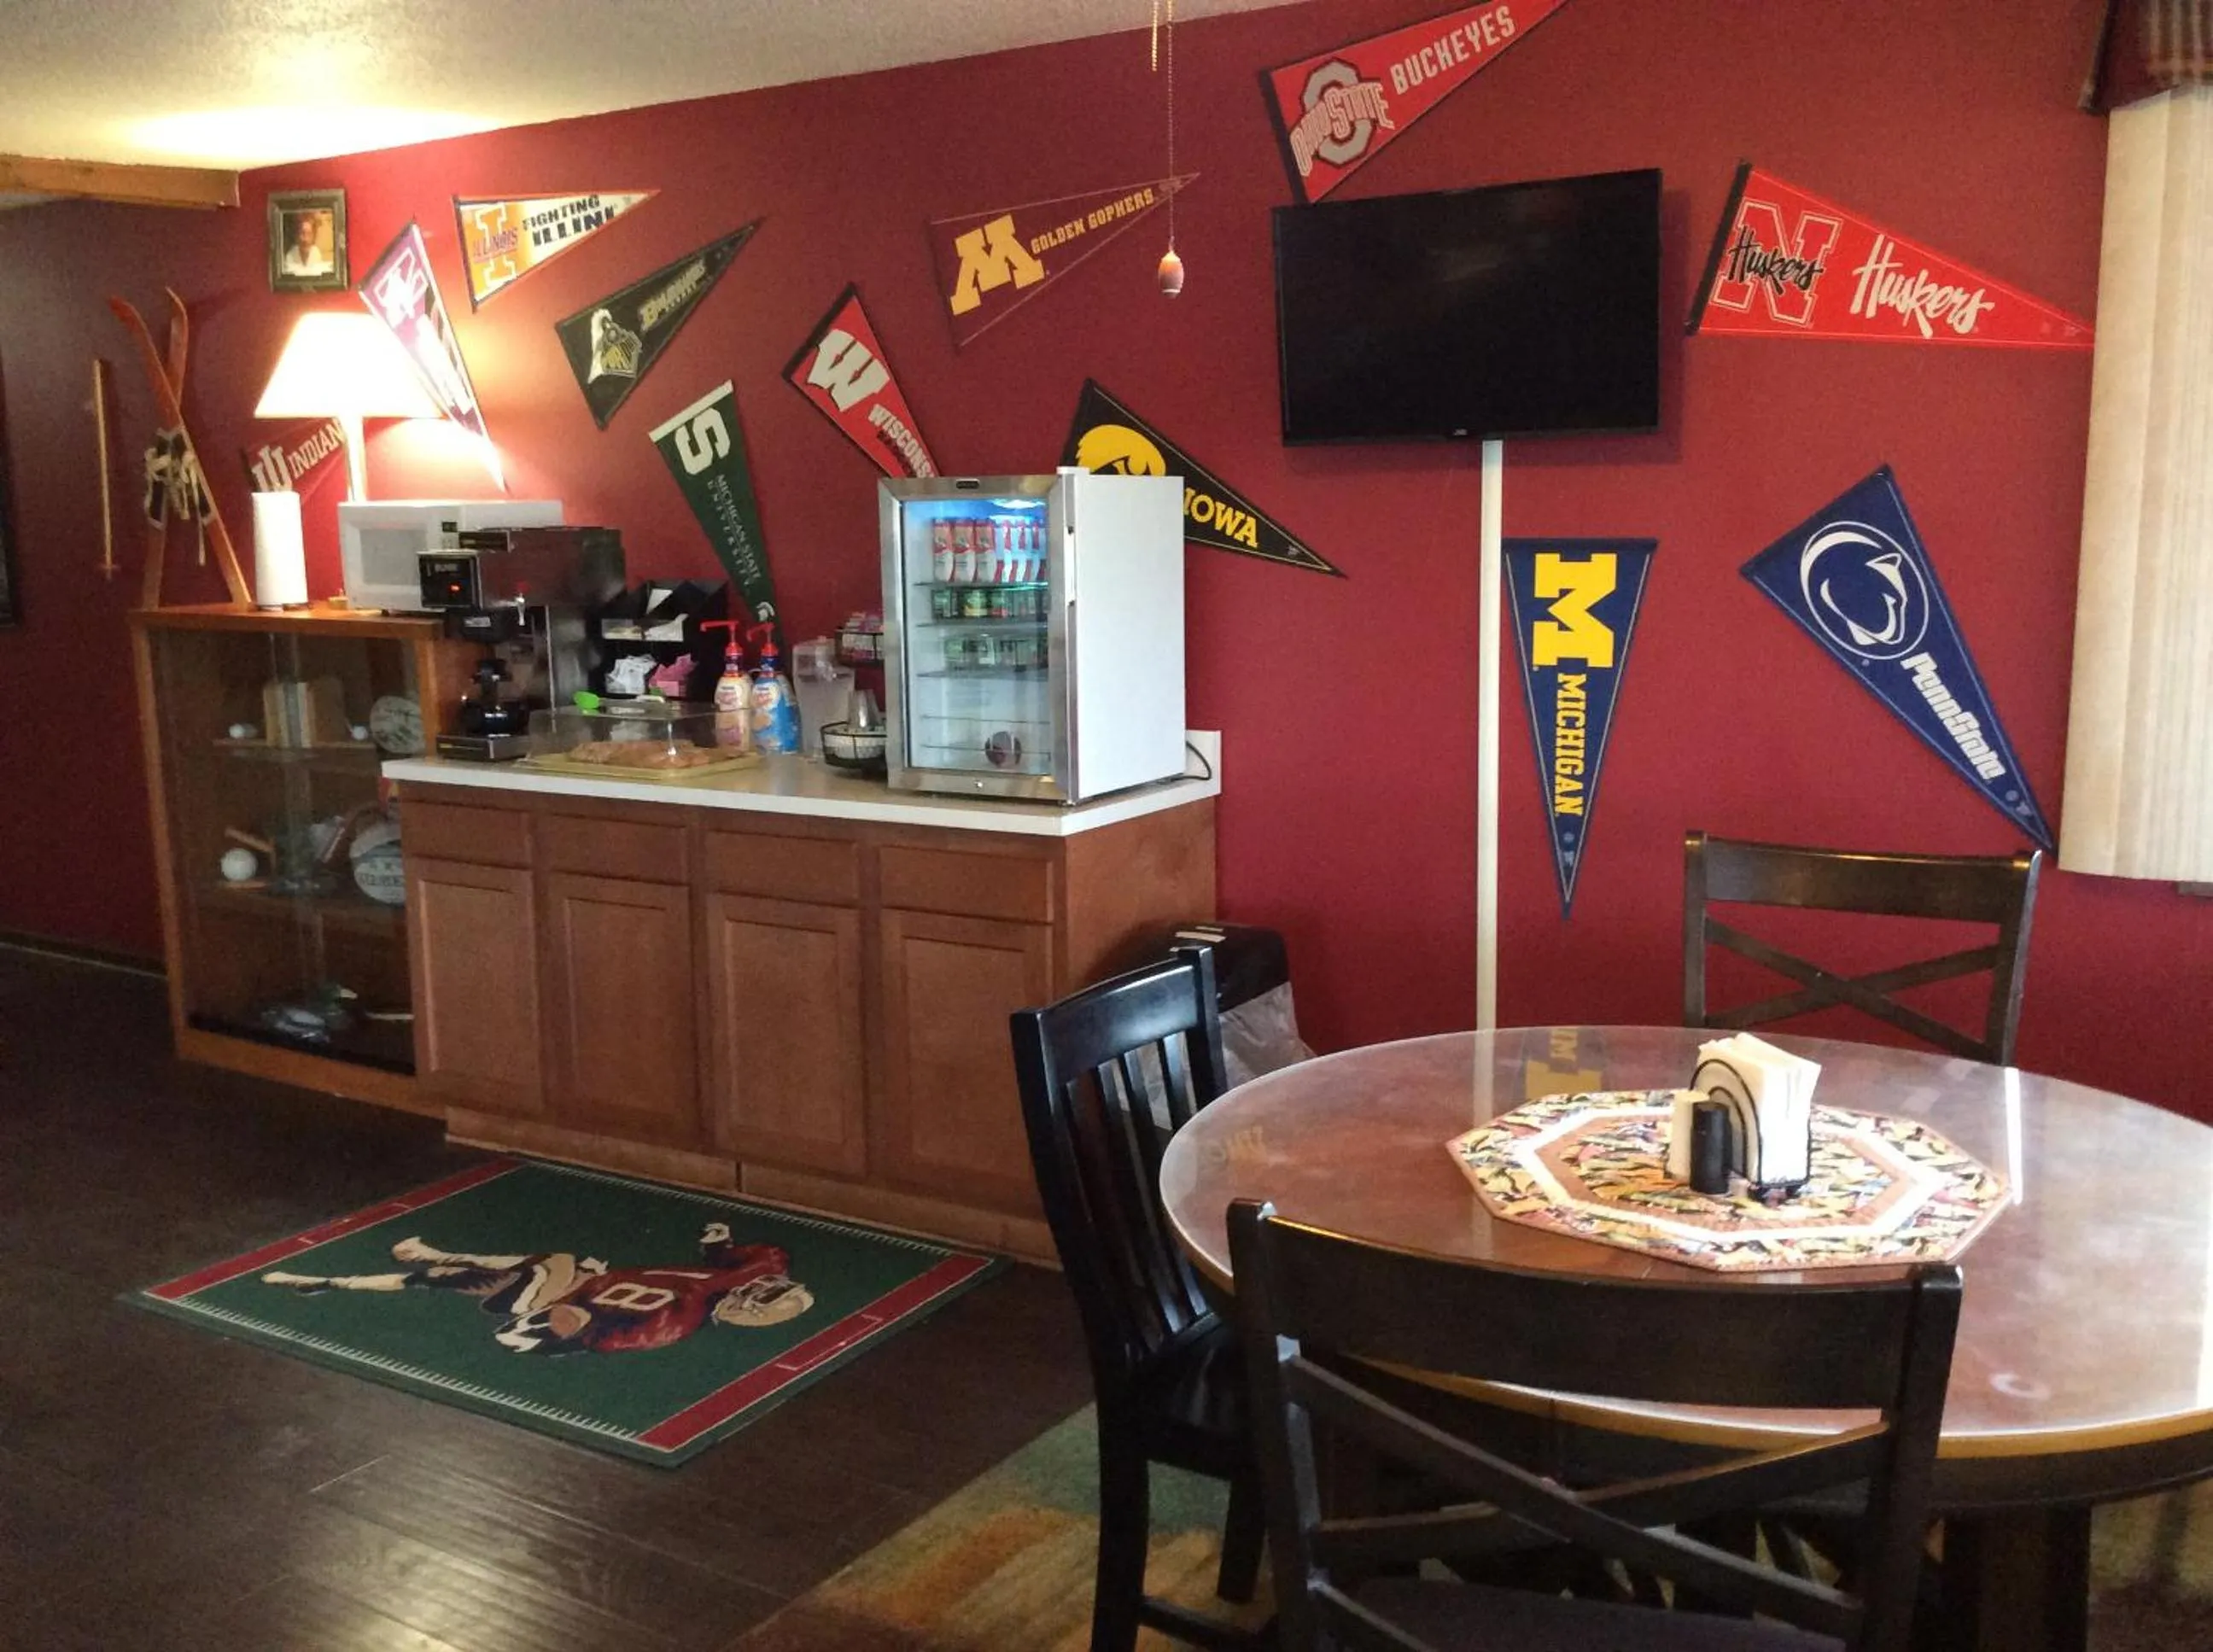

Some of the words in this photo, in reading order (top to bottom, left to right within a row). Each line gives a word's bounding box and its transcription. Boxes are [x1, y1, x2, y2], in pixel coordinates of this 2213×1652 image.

[1390, 5, 1515, 96] BUCKEYES
[1323, 82, 1396, 139] STATE
[522, 194, 600, 231] FIGHTING
[1030, 218, 1086, 255] GOLDEN
[1088, 187, 1154, 230] GOPHERS
[949, 213, 1046, 316] M
[1710, 196, 1843, 328] N
[1726, 225, 1825, 296] Huskers
[1848, 233, 1995, 340] Huskers
[807, 329, 890, 413] W
[674, 406, 732, 476] S
[716, 474, 747, 543] MICHIGAN
[741, 544, 762, 581] STATE
[1183, 486, 1258, 549] IOWA
[1533, 552, 1618, 668] M
[1554, 672, 1587, 818] MICHIGAN
